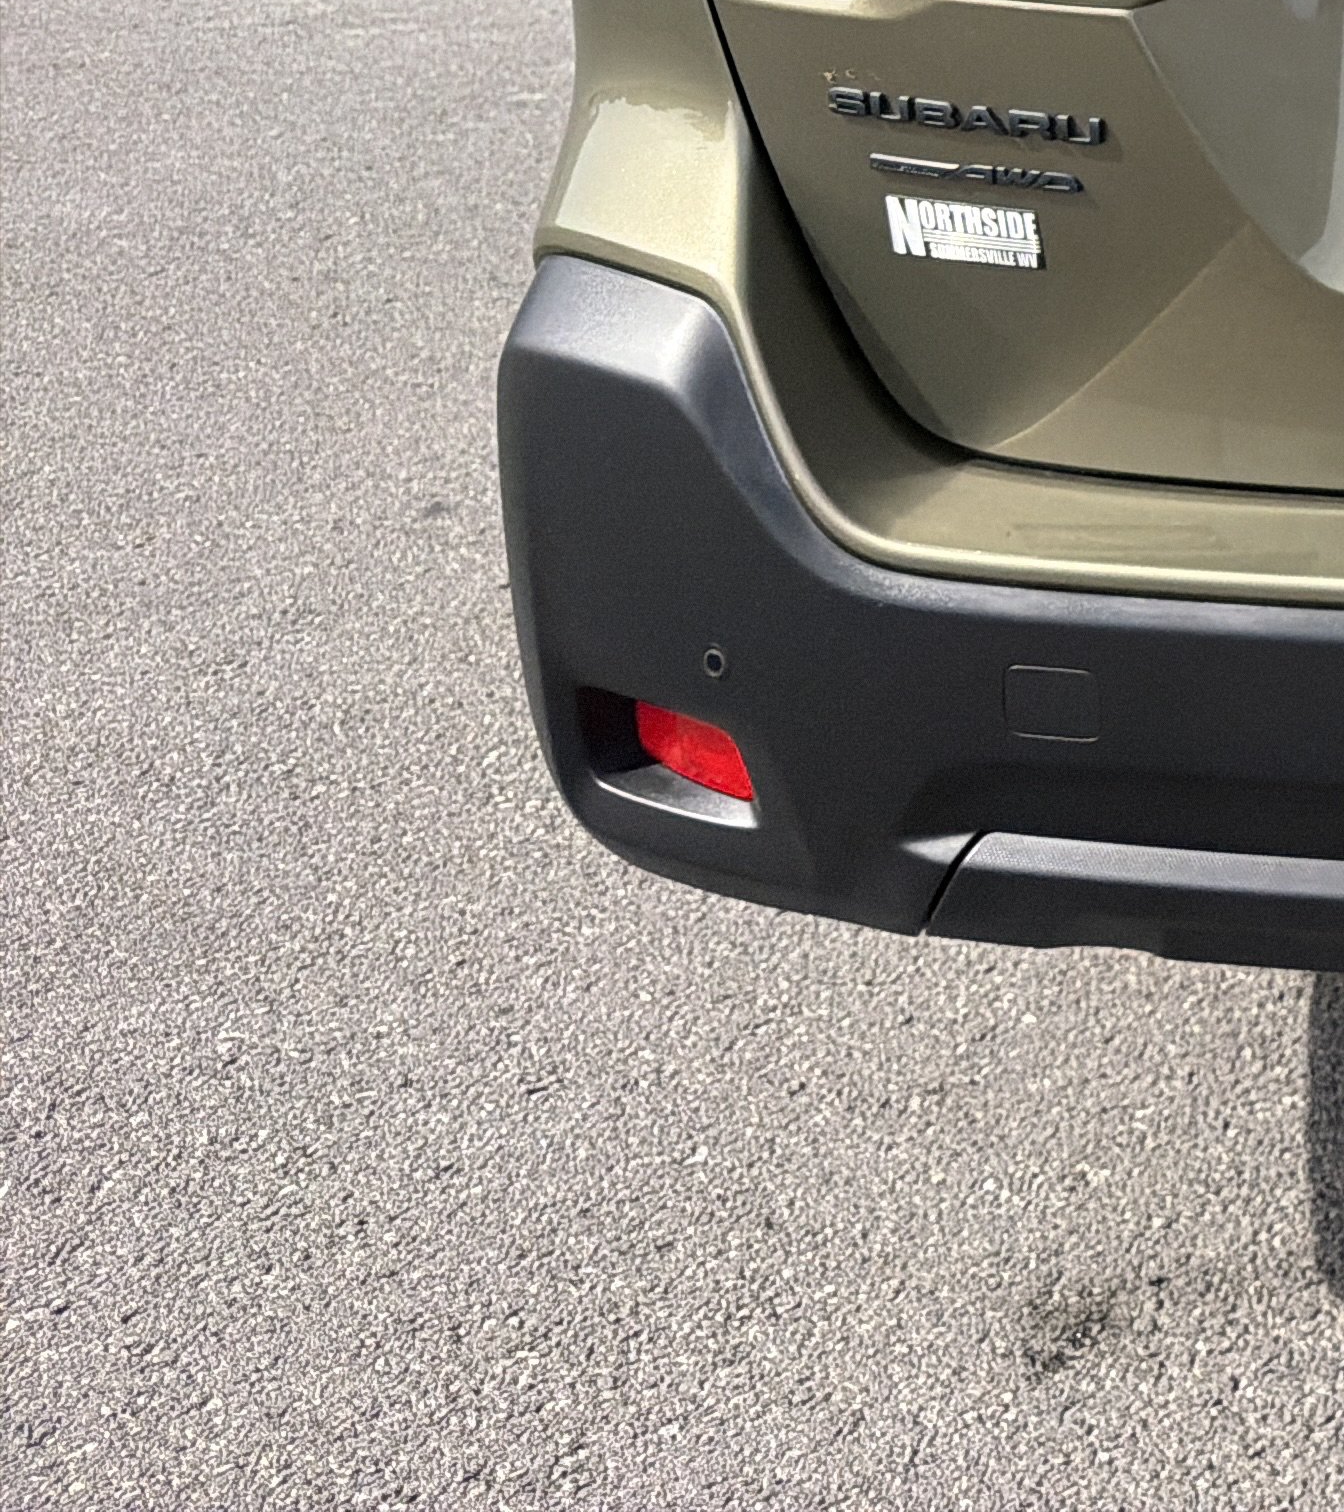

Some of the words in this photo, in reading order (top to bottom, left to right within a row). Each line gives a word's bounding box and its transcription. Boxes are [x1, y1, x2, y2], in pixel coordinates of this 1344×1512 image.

[827, 86, 1107, 145] SUBARU
[884, 194, 1040, 257] NORTHSIDE
[929, 242, 1016, 266] SUMMERSVILLE
[1016, 252, 1039, 269] WV
